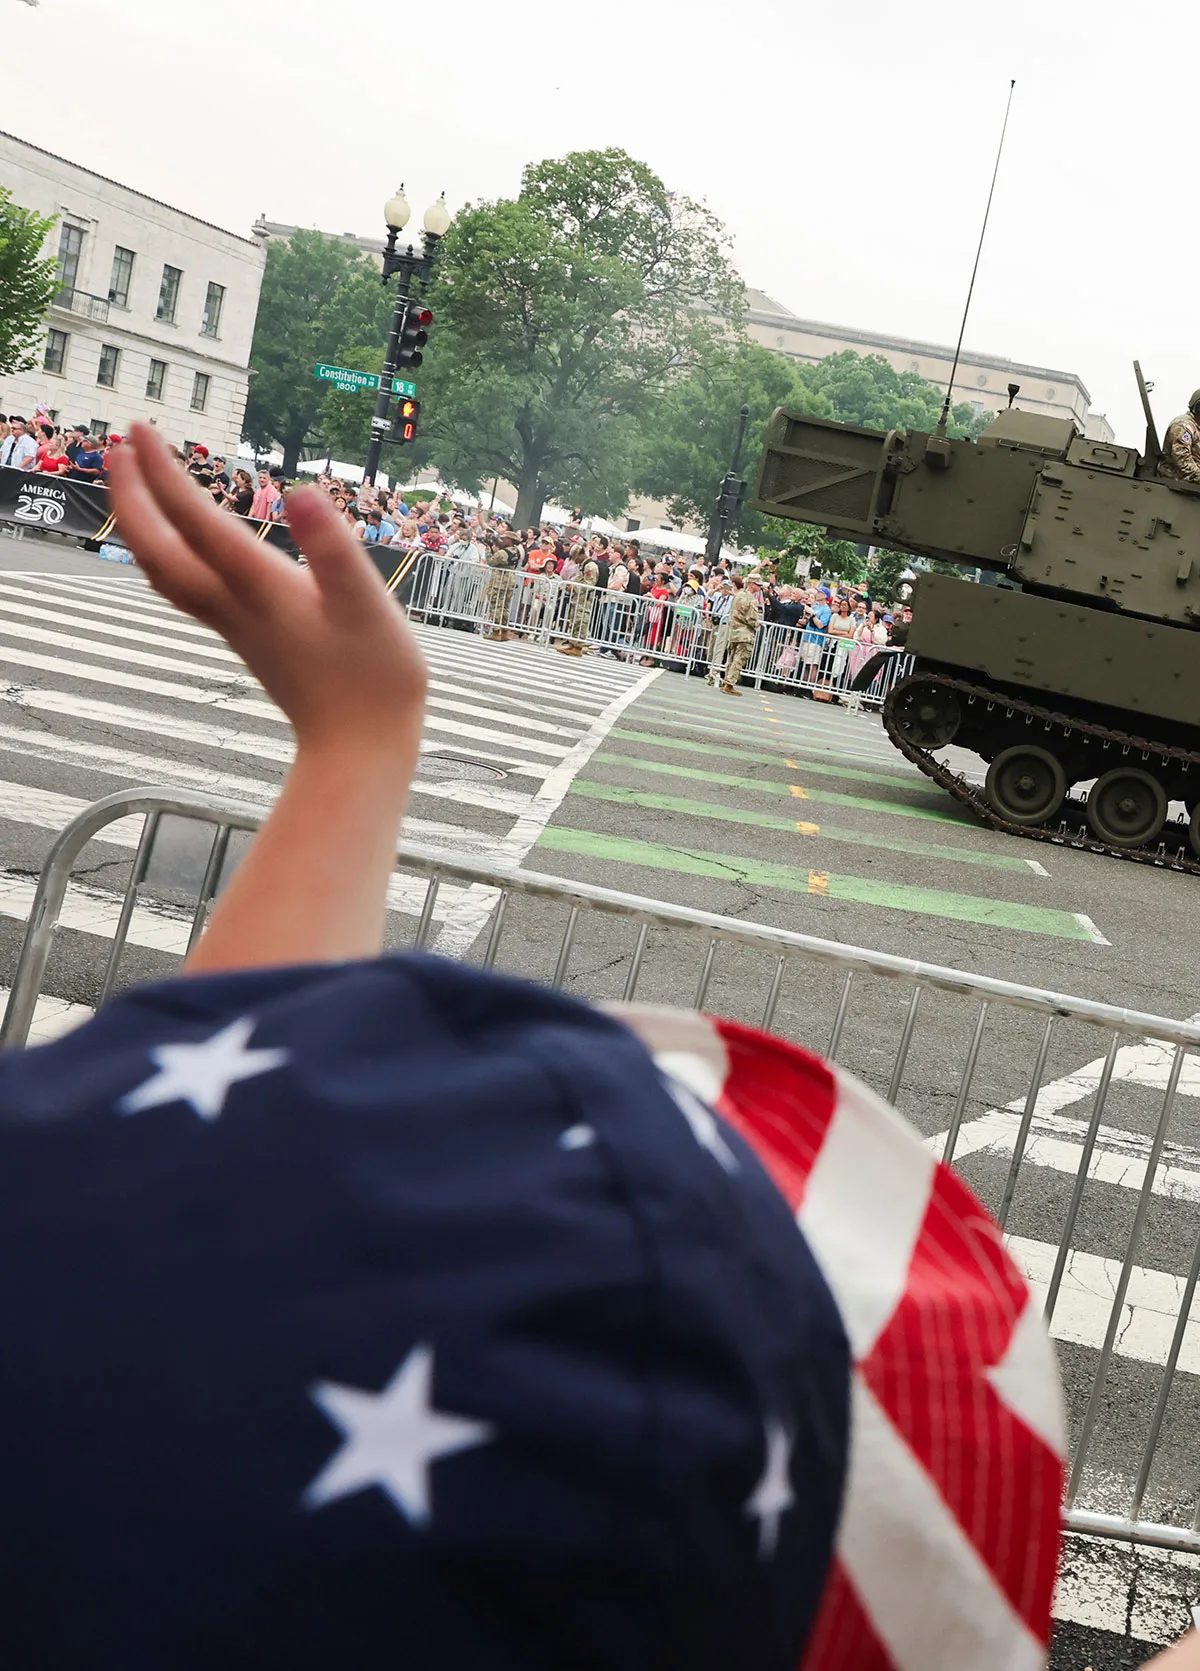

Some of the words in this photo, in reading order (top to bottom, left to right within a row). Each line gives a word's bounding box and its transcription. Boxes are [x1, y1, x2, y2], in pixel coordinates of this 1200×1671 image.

[320, 366, 367, 385] Constitution
[336, 381, 356, 392] 1800
[395, 381, 405, 393] 18
[20, 483, 67, 501] AMERICA
[14, 495, 65, 525] 250
